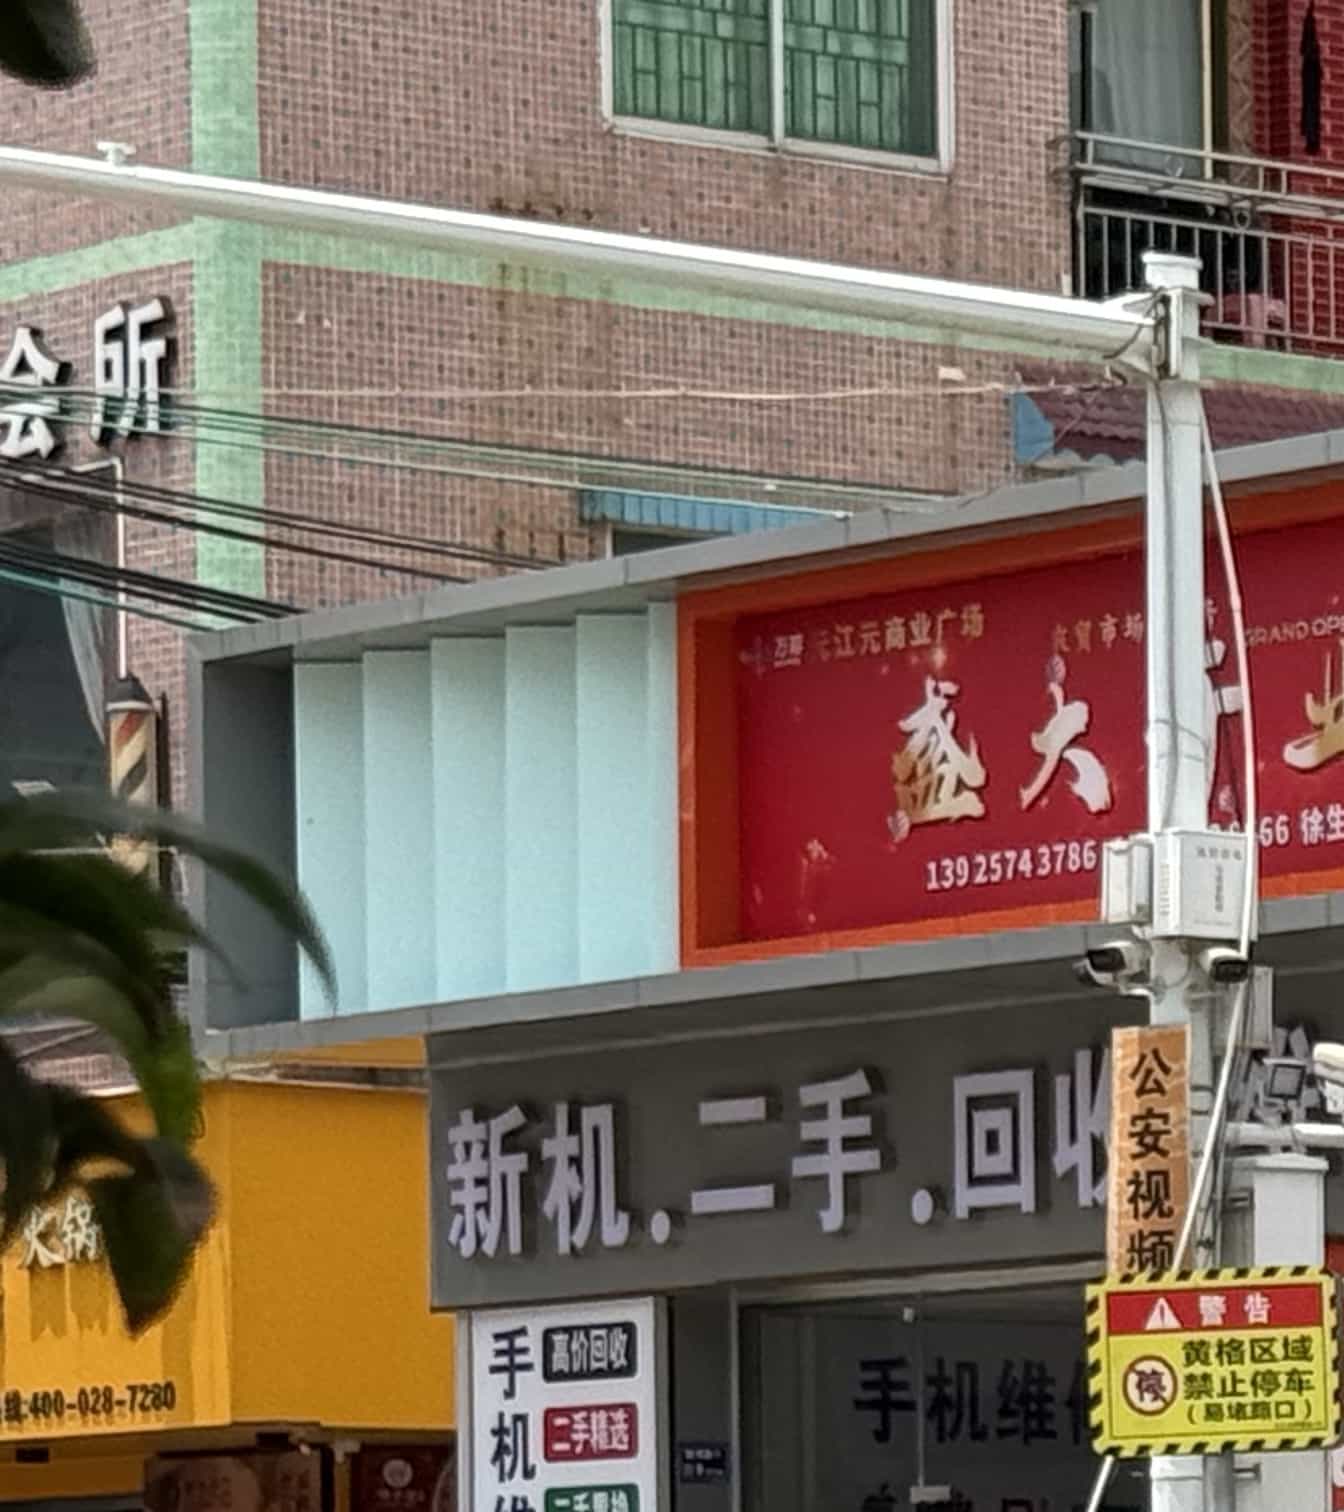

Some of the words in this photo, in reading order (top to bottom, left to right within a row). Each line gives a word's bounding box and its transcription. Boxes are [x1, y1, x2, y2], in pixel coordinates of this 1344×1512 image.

[0, 300, 171, 460] 会所
[816, 603, 984, 662] 江元商业广场
[926, 838, 1098, 892] 13925743786
[1199, 1291, 1272, 1326] 警告
[551, 1328, 628, 1375] 高价回收
[1182, 1335, 1313, 1368] 黄格区域
[1182, 1367, 1315, 1402] 禁止停车
